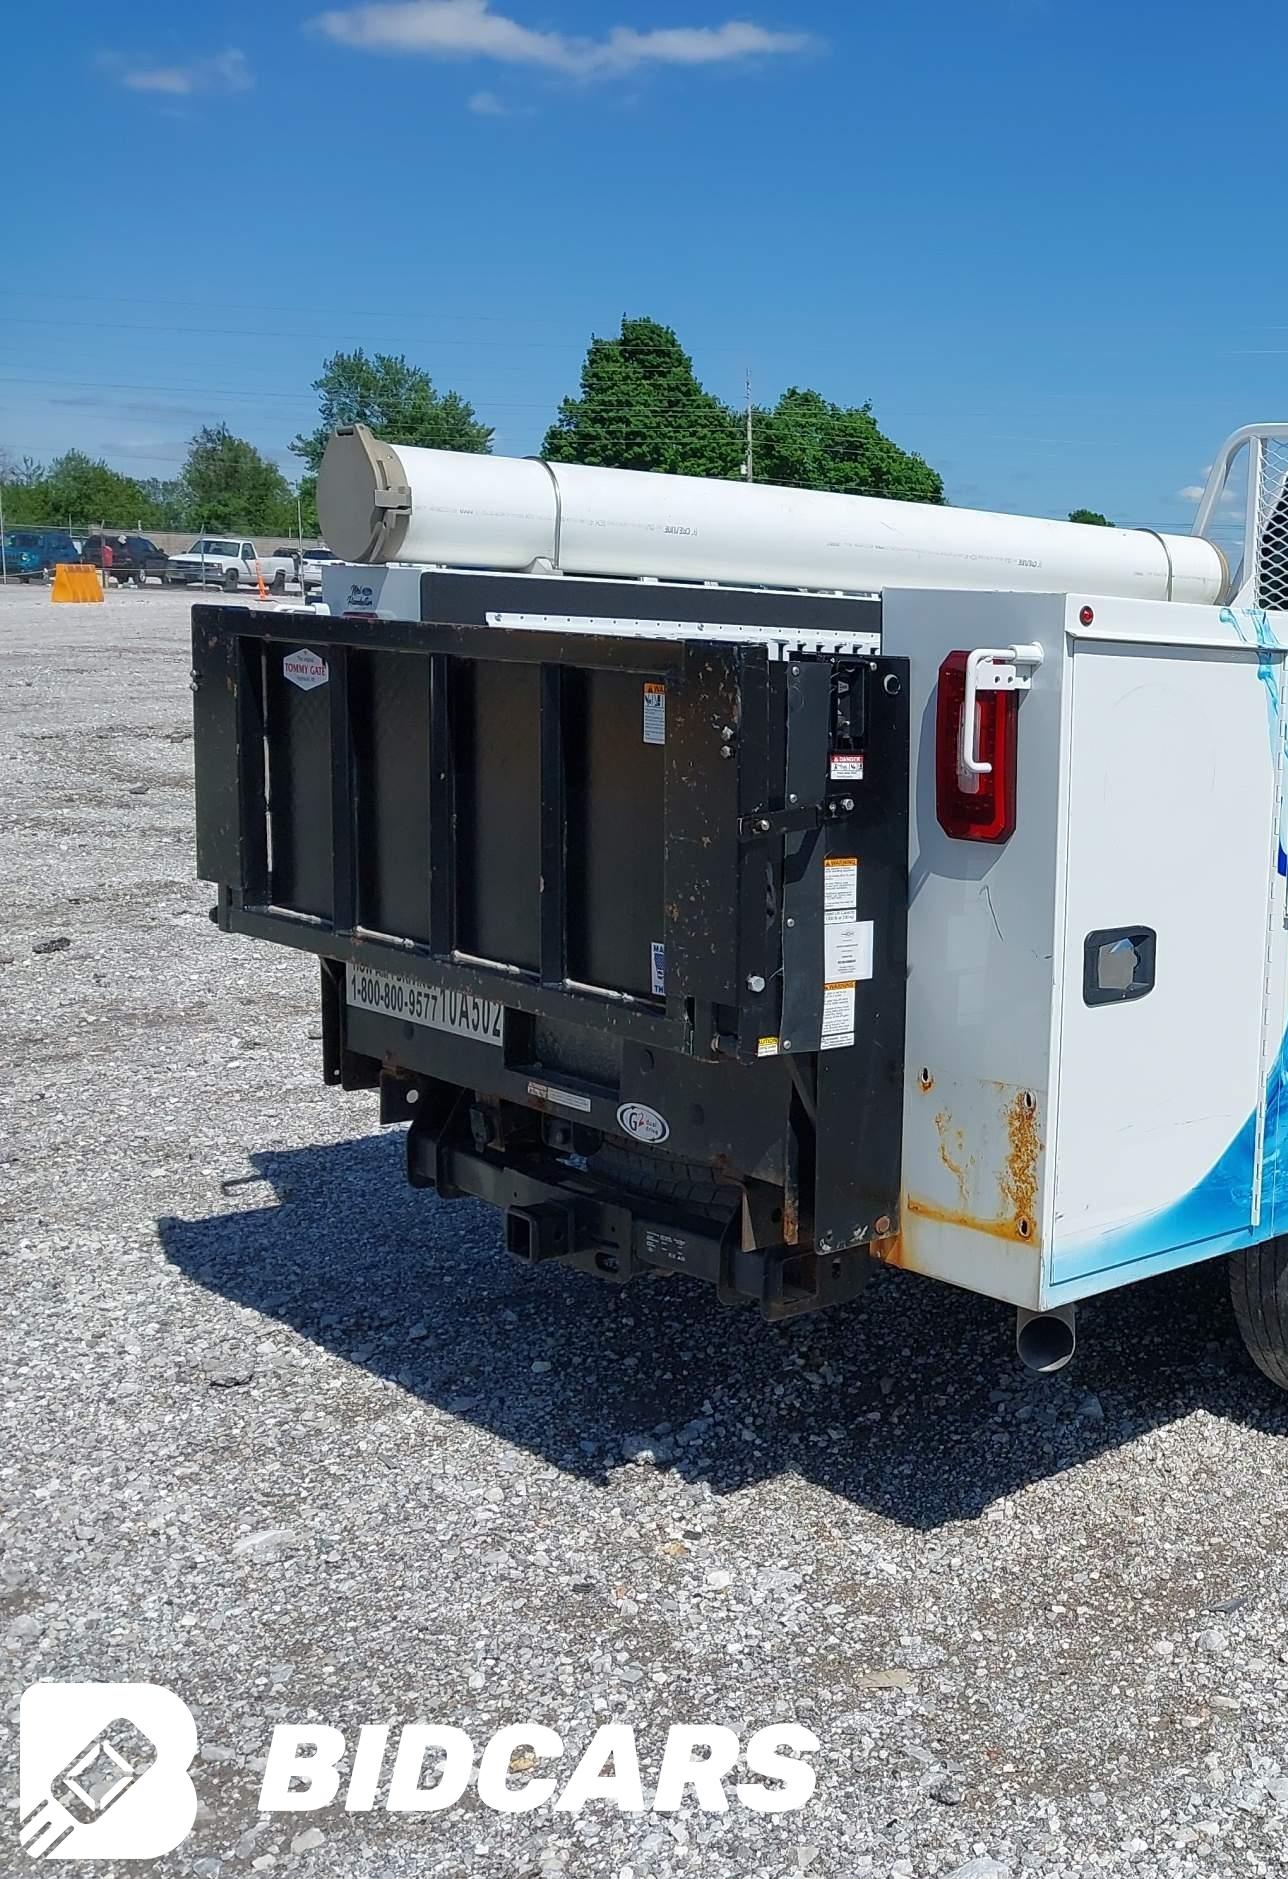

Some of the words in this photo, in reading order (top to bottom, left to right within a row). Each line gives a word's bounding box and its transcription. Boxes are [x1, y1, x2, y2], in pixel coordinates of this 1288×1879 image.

[285, 662, 308, 675] TOMMY
[310, 664, 326, 676] GATE
[351, 975, 438, 1021] 1-800-800-9577
